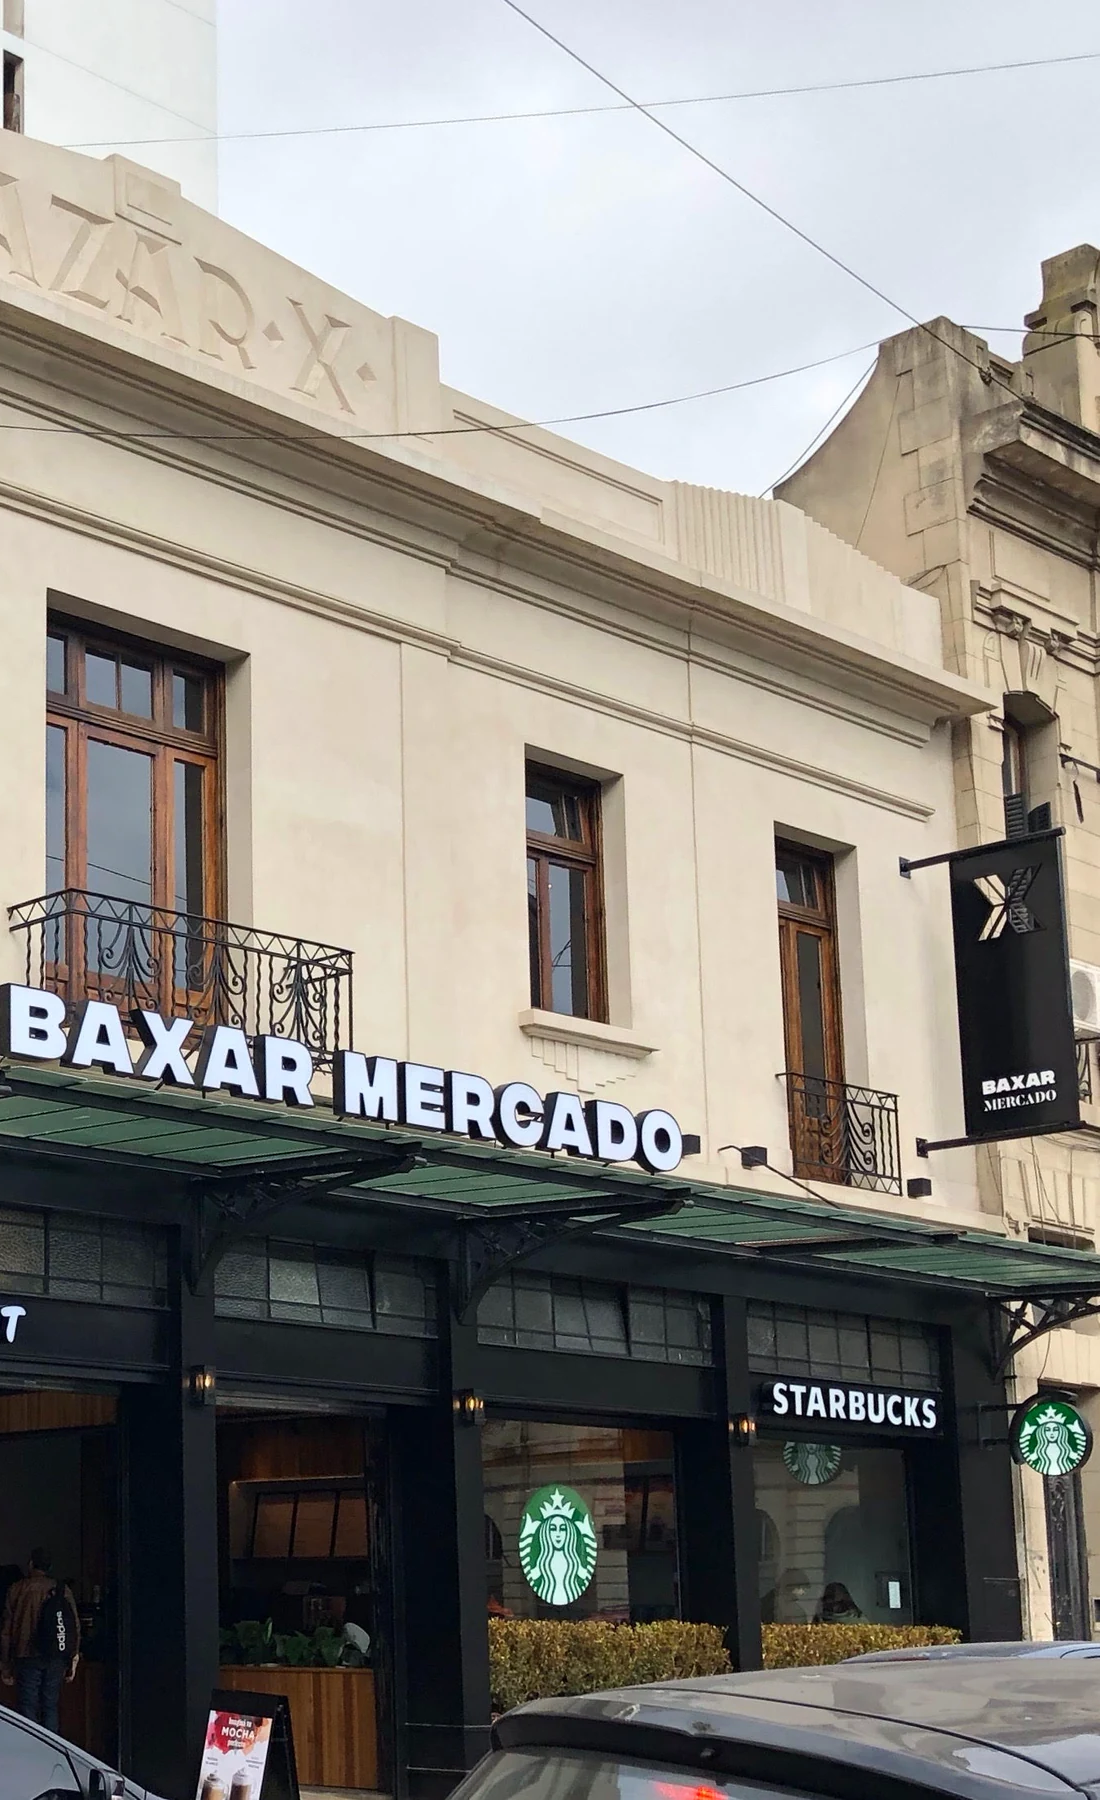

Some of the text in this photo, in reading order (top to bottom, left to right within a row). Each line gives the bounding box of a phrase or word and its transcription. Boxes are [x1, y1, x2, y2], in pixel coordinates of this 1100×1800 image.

[0, 982, 683, 1173] BAXAR MERCADO
[982, 1070, 1056, 1096] BAXAR
[983, 1089, 1057, 1112] MERCADO
[772, 1382, 937, 1429] STARBUCKS
[56, 1611, 66, 1651] adidas
[221, 1726, 255, 1740] MOCHA
